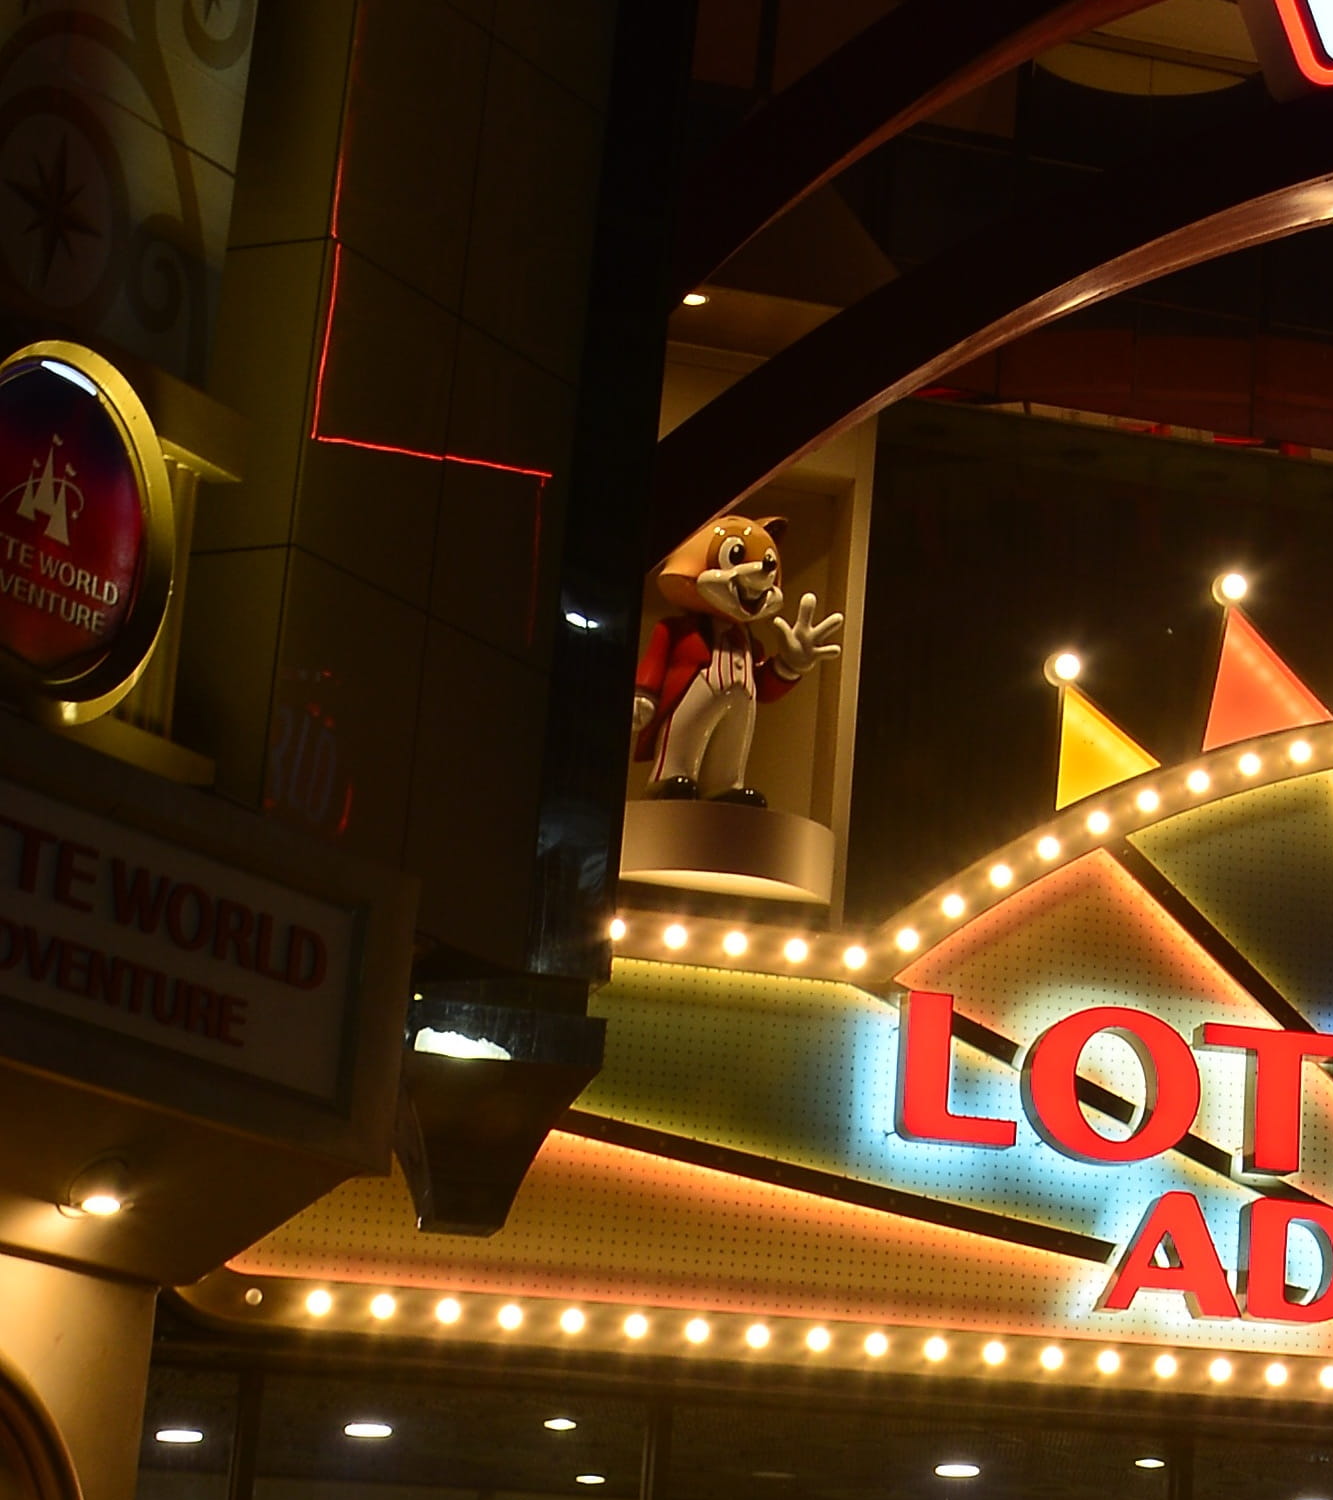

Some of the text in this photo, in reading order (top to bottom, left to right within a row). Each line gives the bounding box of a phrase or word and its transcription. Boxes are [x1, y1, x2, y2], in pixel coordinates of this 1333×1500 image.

[0, 568, 105, 633] VENTURE
[39, 551, 119, 606] WORLD
[112, 857, 328, 991] WORLD
[0, 917, 249, 1047] DVENTURE
